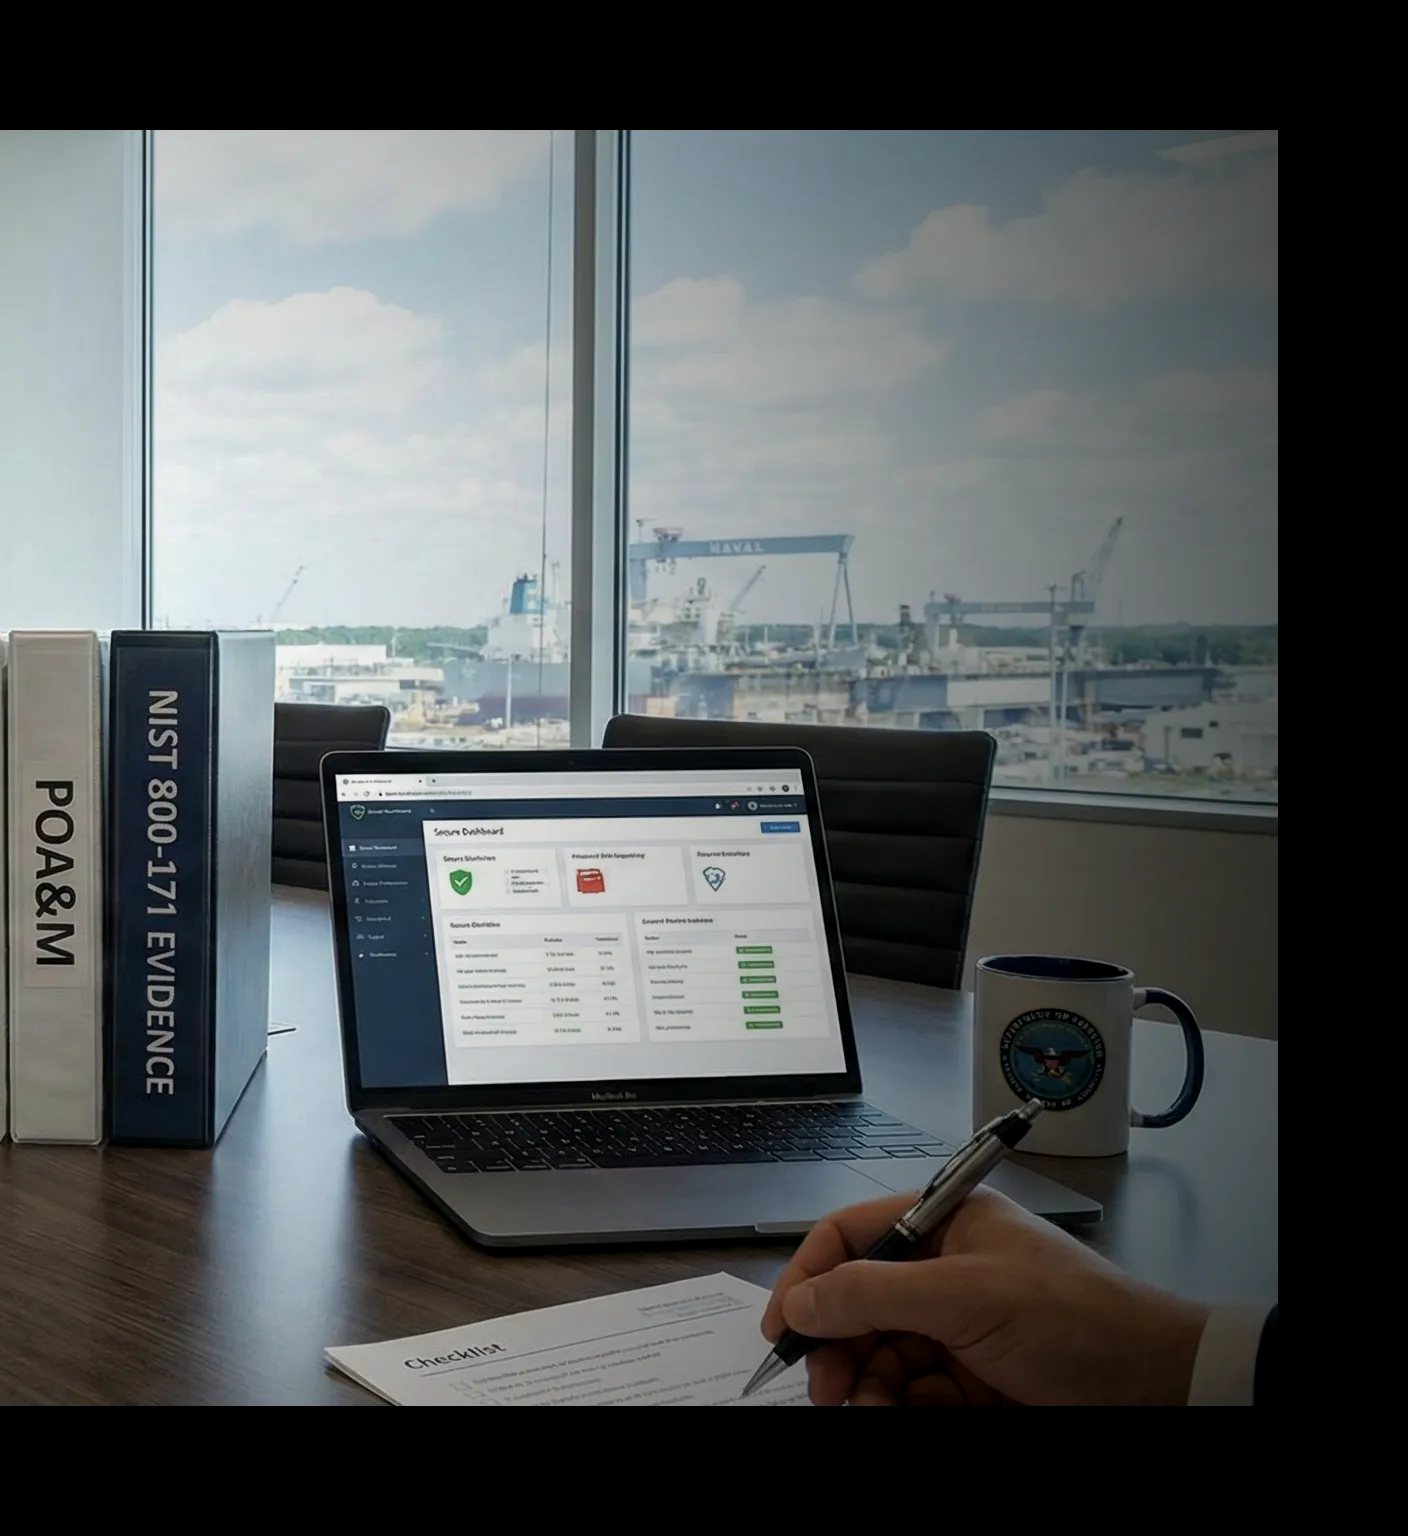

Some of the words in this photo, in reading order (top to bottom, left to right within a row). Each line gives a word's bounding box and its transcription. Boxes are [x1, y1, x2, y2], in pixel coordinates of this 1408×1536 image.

[710, 541, 765, 555] NAVAL
[147, 690, 178, 770] NIST
[34, 779, 77, 966] POA&M
[147, 778, 178, 916] 800-171
[145, 931, 176, 1096] EVIDENCE
[403, 1342, 507, 1372] Checklist
